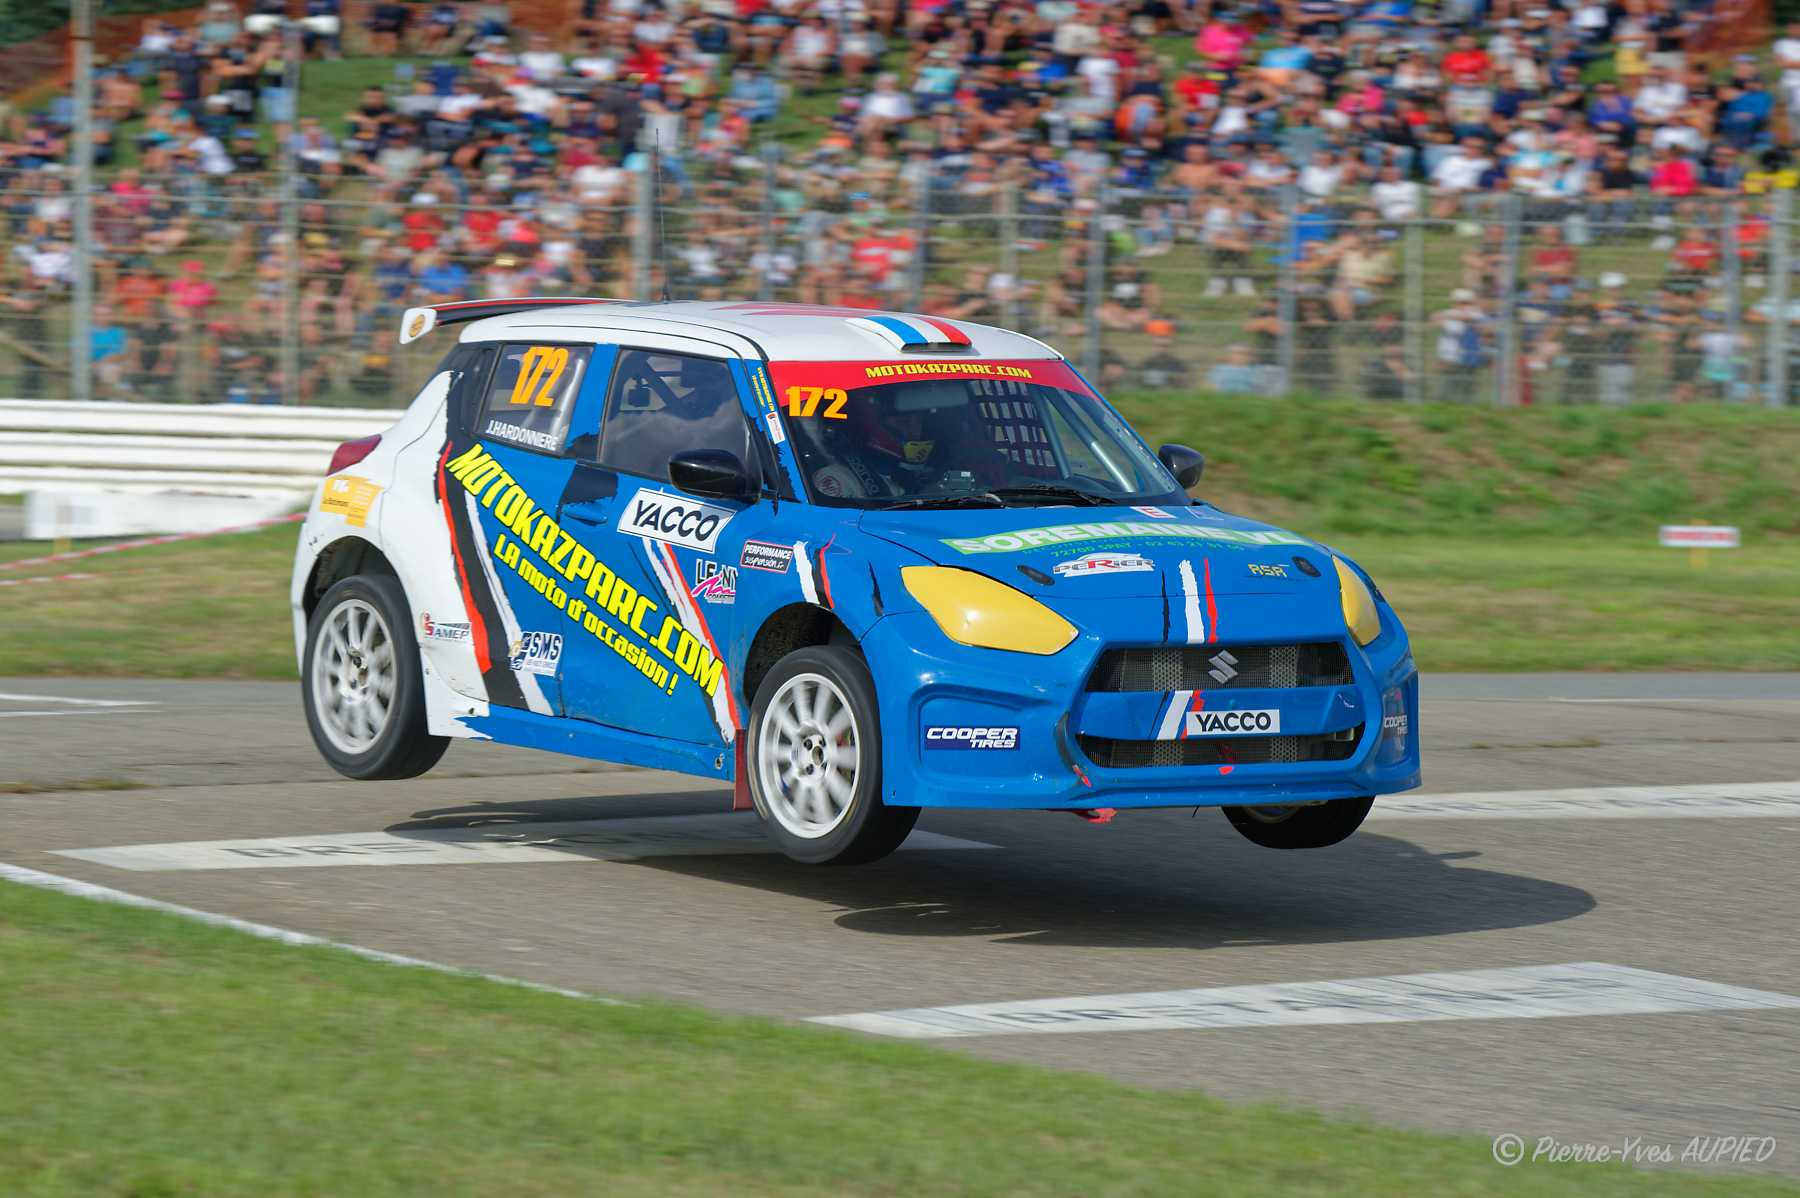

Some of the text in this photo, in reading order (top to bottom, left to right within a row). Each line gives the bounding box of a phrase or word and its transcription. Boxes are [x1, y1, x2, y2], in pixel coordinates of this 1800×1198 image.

[510, 346, 569, 407] 172
[865, 363, 1032, 378] MOTOKAZPARC.COM
[785, 386, 848, 418] 172
[633, 500, 720, 541] YACCO
[744, 544, 793, 560] PERFORMANCE
[445, 443, 724, 697] MOTOKAZPARC.COM
[494, 534, 679, 697] LA moto d'occasion !
[926, 727, 1018, 740] COOPER
[1196, 712, 1272, 732] YACCO
[969, 738, 1016, 749] TIRES
